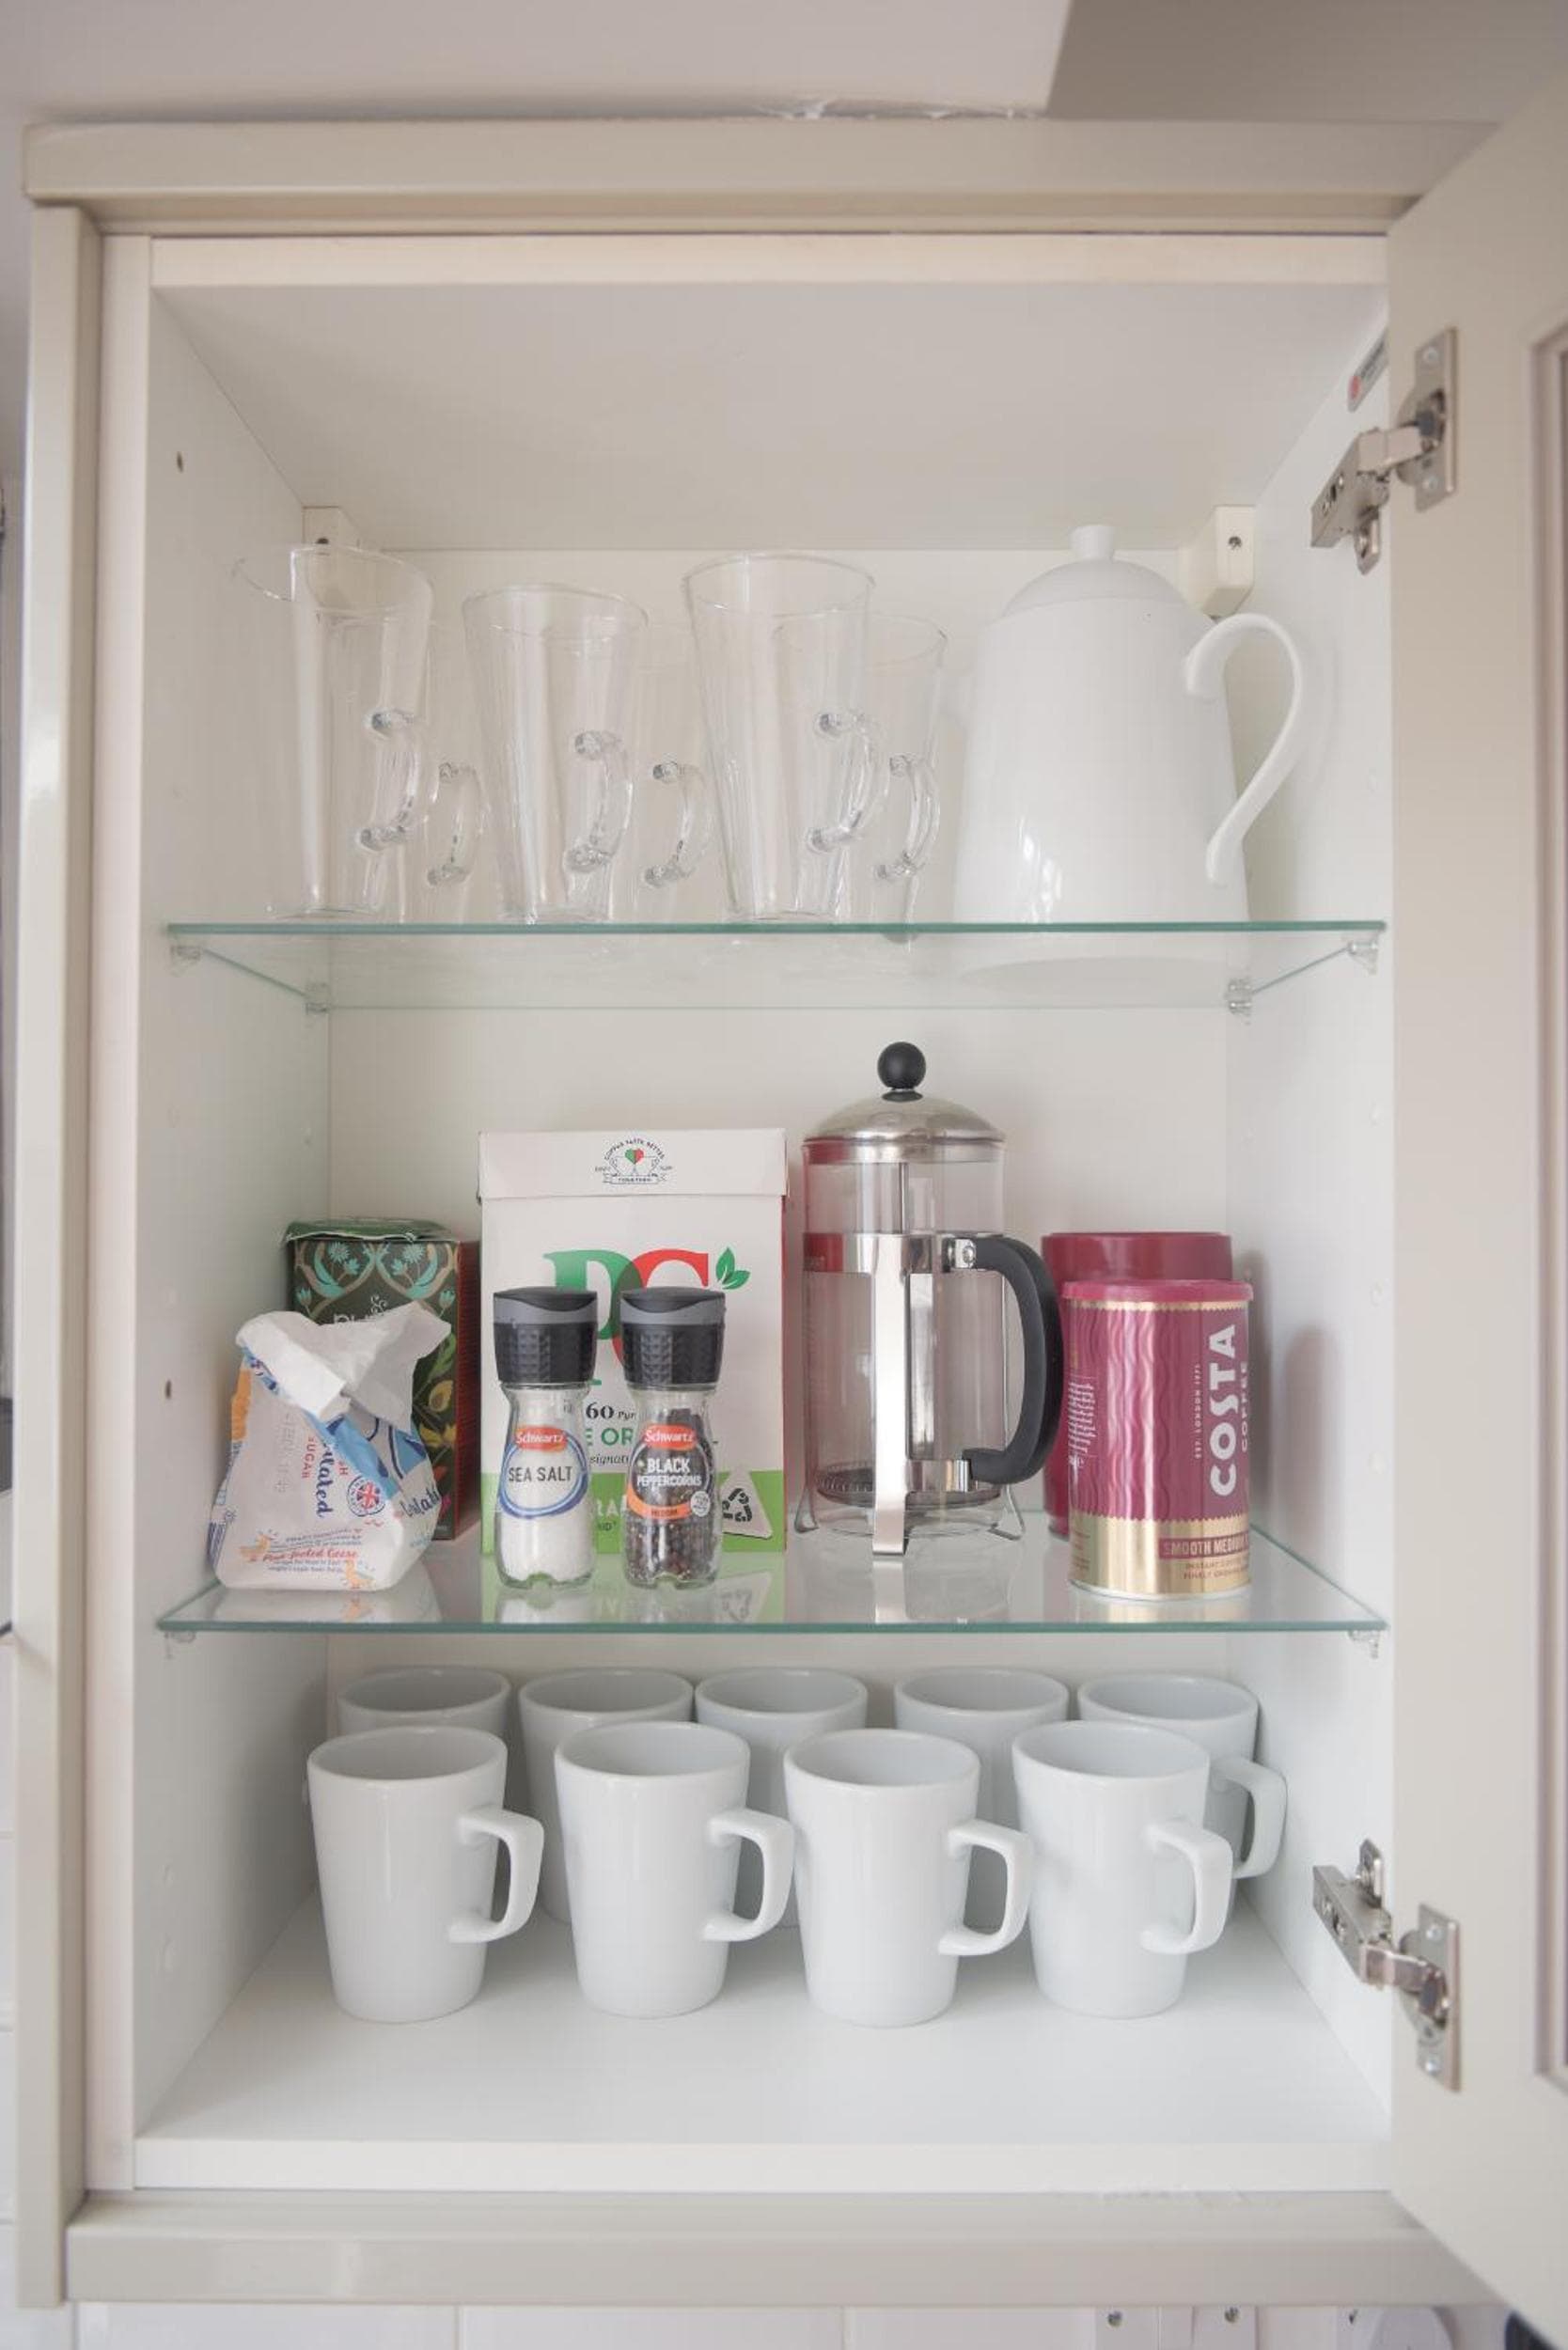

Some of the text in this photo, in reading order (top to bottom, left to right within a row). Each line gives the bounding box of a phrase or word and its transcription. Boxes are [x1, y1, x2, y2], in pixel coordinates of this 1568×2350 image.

[586, 1402, 614, 1419] 60
[1209, 1324, 1238, 1496] COSTA
[1239, 1361, 1248, 1453] COFFEE
[515, 1429, 564, 1444] Schwartz
[644, 1429, 695, 1443] Schwartz
[509, 1465, 573, 1482] SEA SALT
[647, 1458, 691, 1473] BLACK
[636, 1475, 702, 1487] PEPPERCORNS
[1164, 1540, 1212, 1556] SMOOTH
